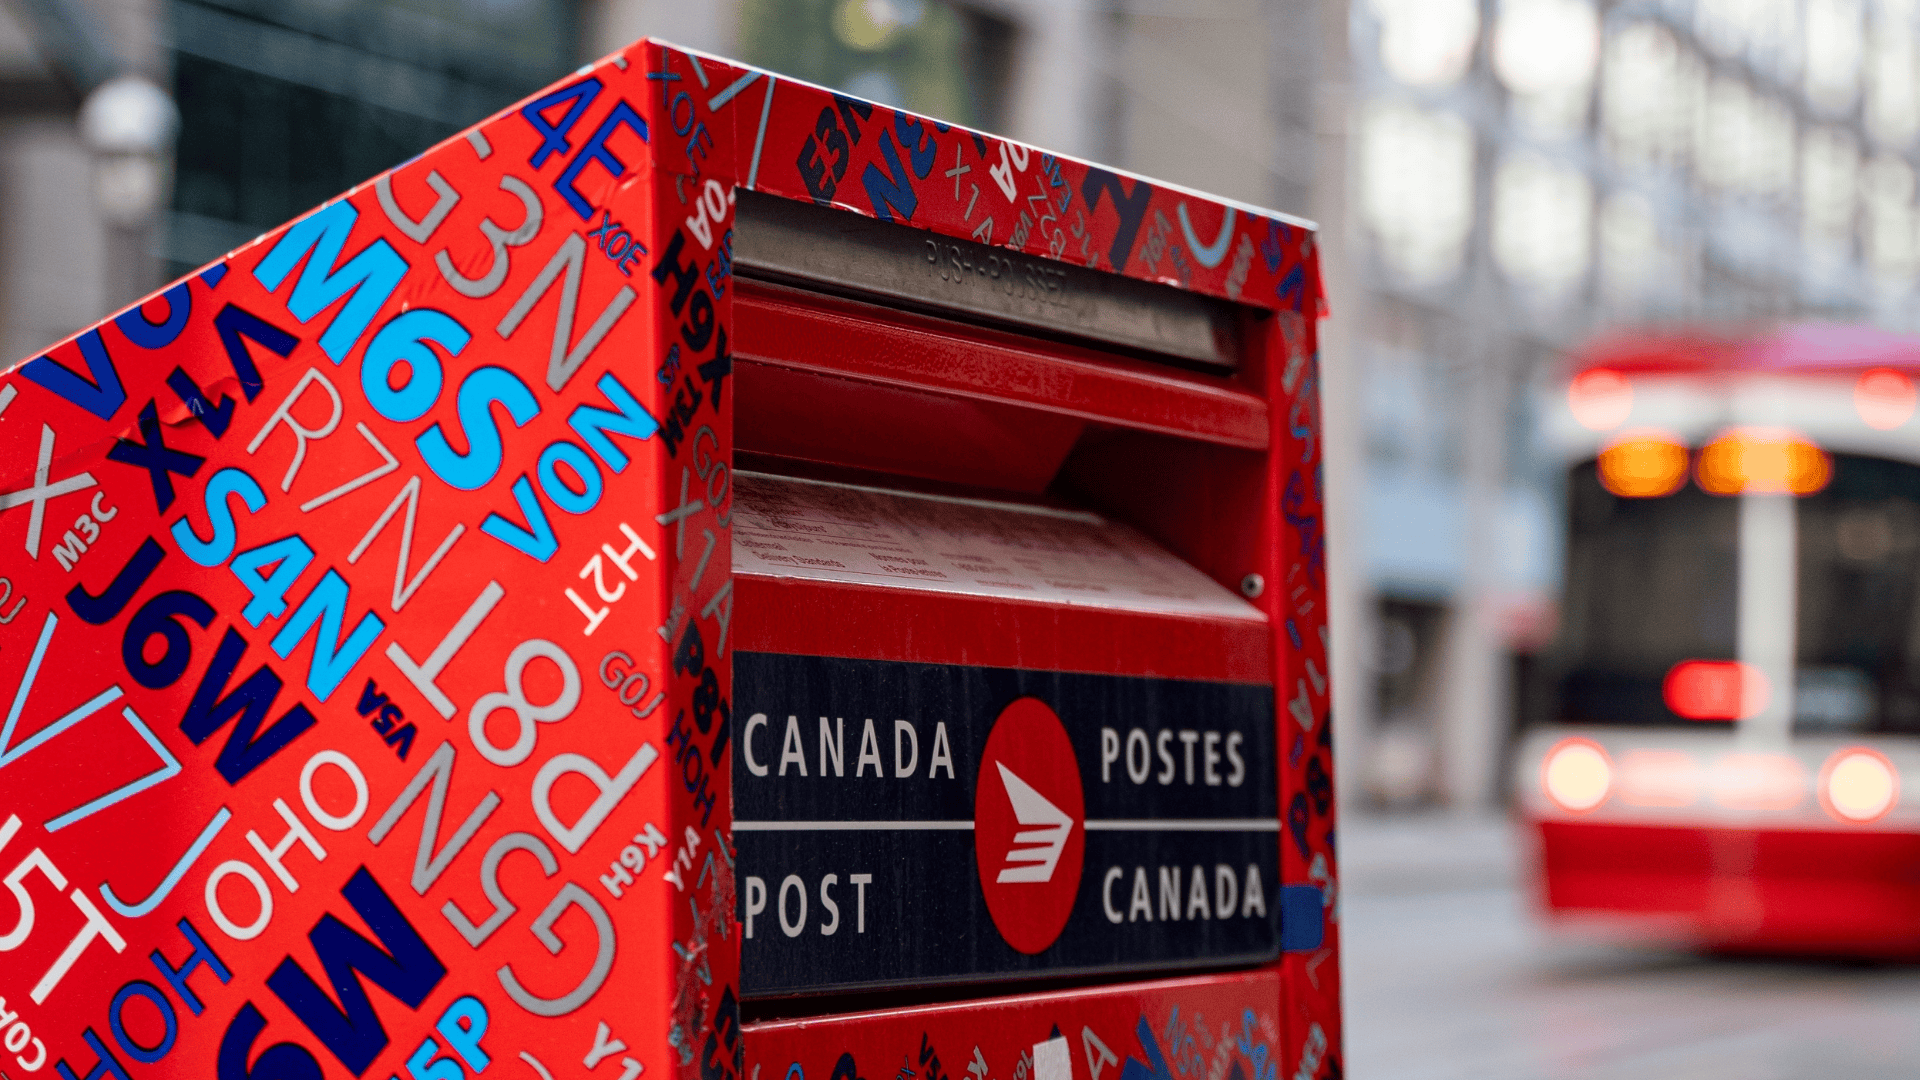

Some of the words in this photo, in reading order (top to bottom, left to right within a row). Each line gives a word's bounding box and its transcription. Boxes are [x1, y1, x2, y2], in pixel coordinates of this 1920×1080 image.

[252, 198, 541, 491] M6S
[651, 229, 733, 413] H9X
[51, 490, 118, 573] M3C
[247, 366, 466, 614] R7N
[170, 467, 386, 703] S4N
[564, 522, 656, 637] H2T
[65, 534, 318, 787] J6W
[356, 678, 418, 761] V5A
[743, 712, 956, 780] CANADA
[1101, 727, 1246, 787] POSTES
[744, 872, 873, 940] POST
[1102, 864, 1267, 924] CANADA
